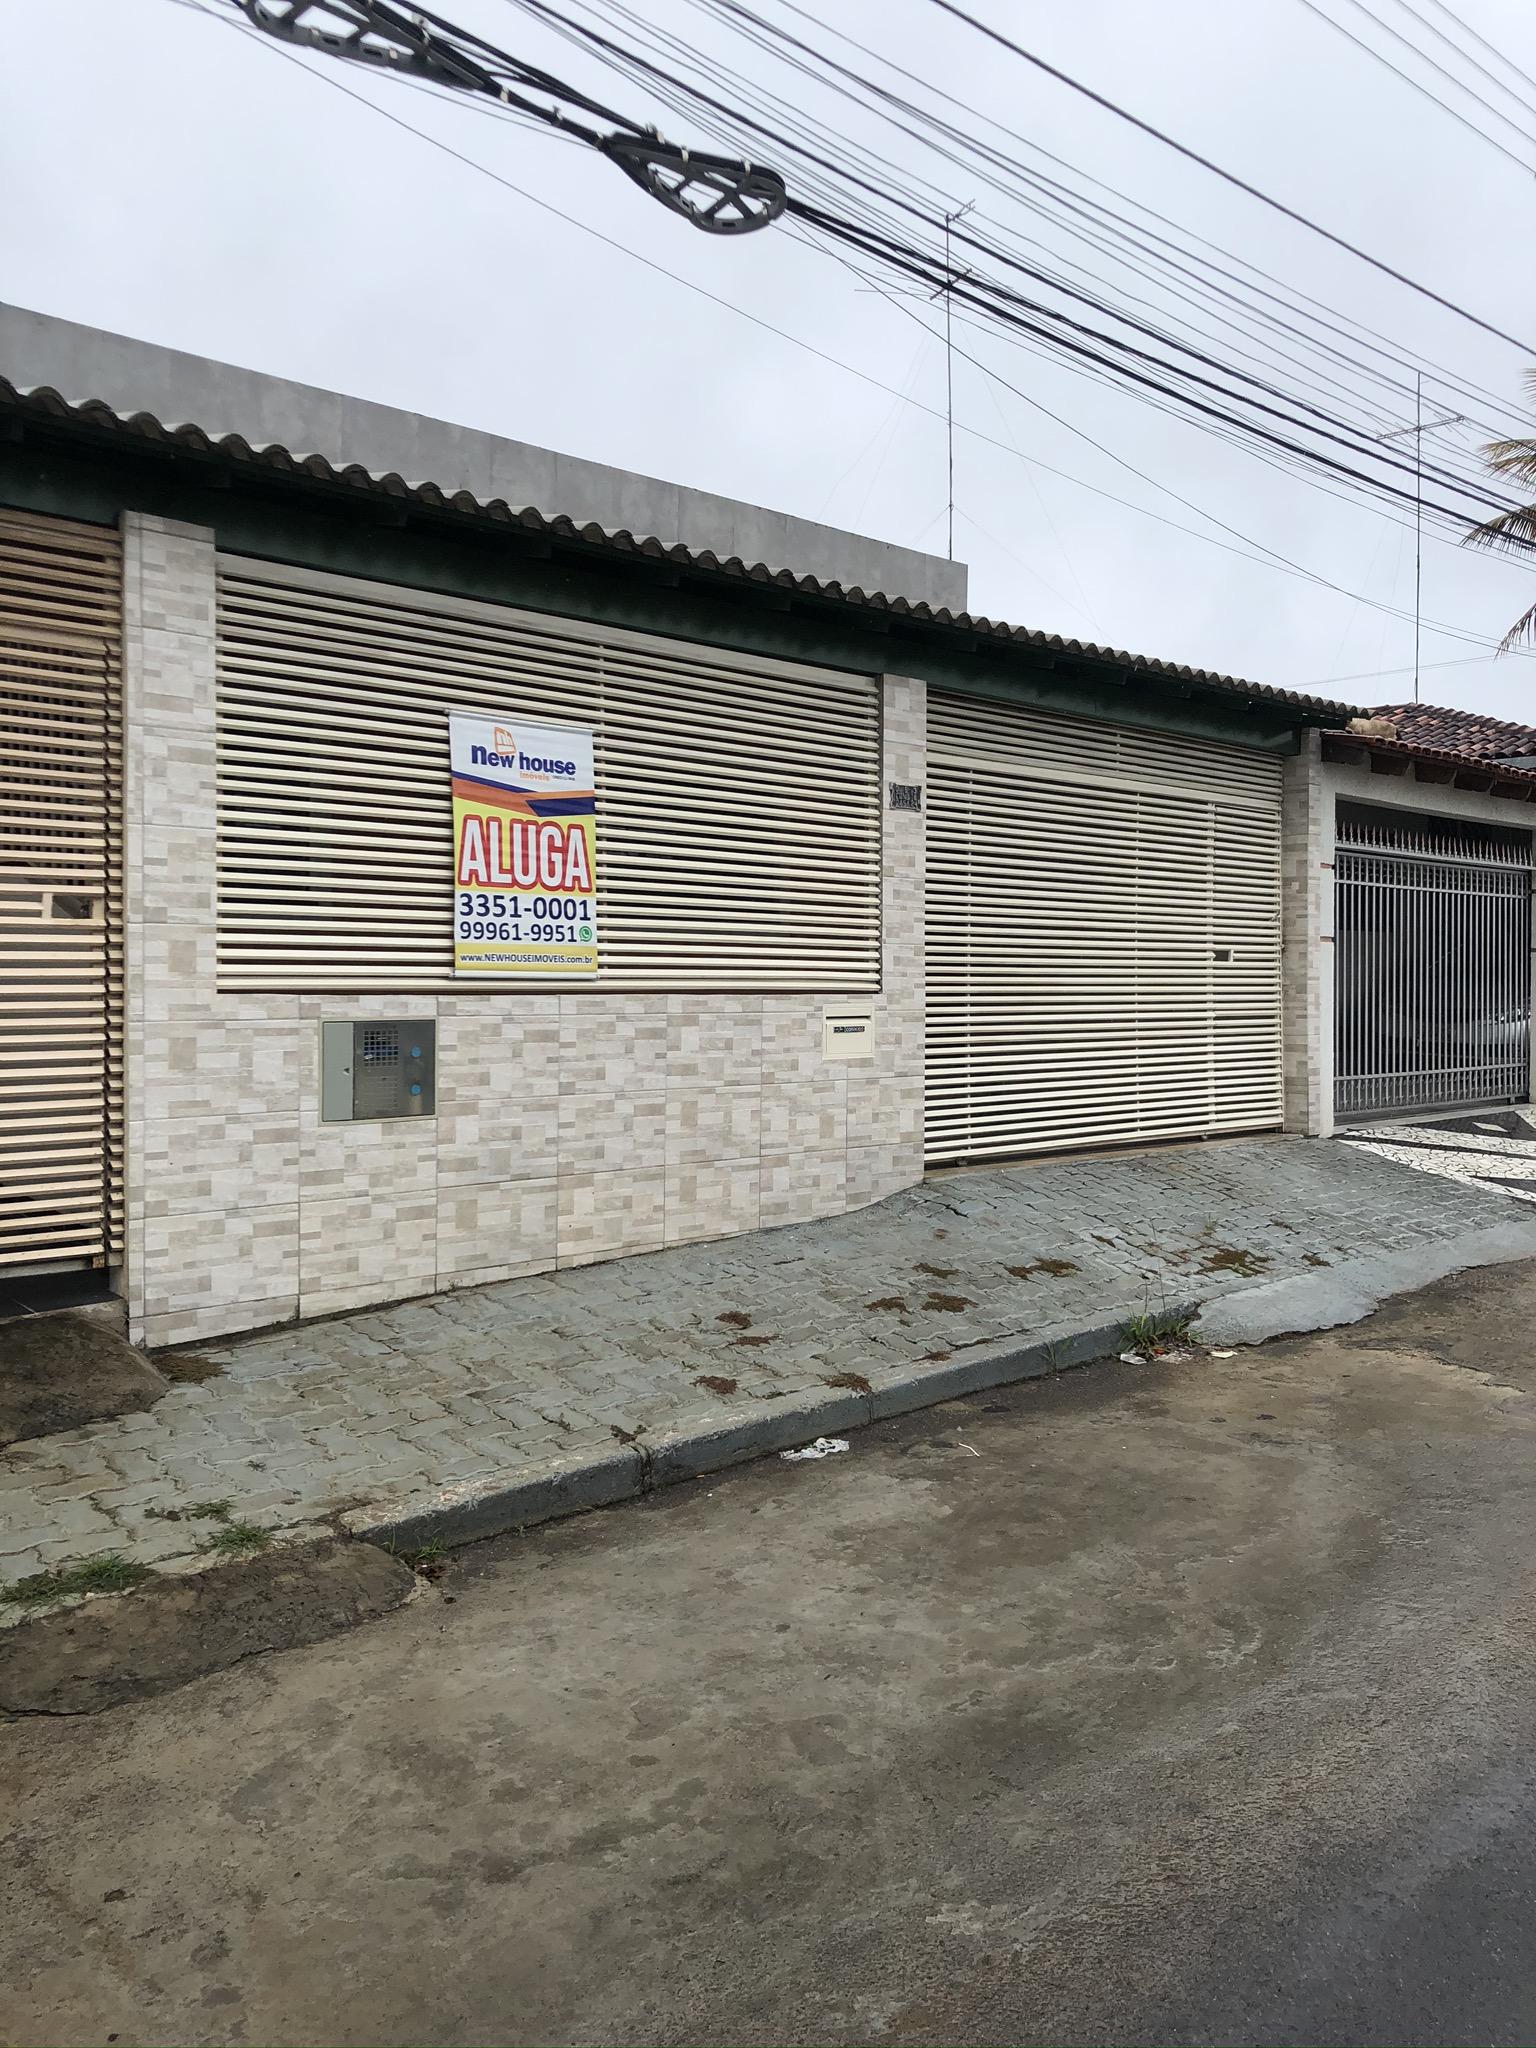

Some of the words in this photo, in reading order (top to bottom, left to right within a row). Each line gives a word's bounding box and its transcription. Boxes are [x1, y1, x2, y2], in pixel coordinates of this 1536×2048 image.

[519, 752, 576, 776] house
[459, 815, 592, 891] ALUGA
[459, 893, 591, 920] 3351-0001
[460, 921, 577, 942] 99961-9951
[460, 953, 593, 964] www.NEWHOUSEIMOVEIS.com.br
